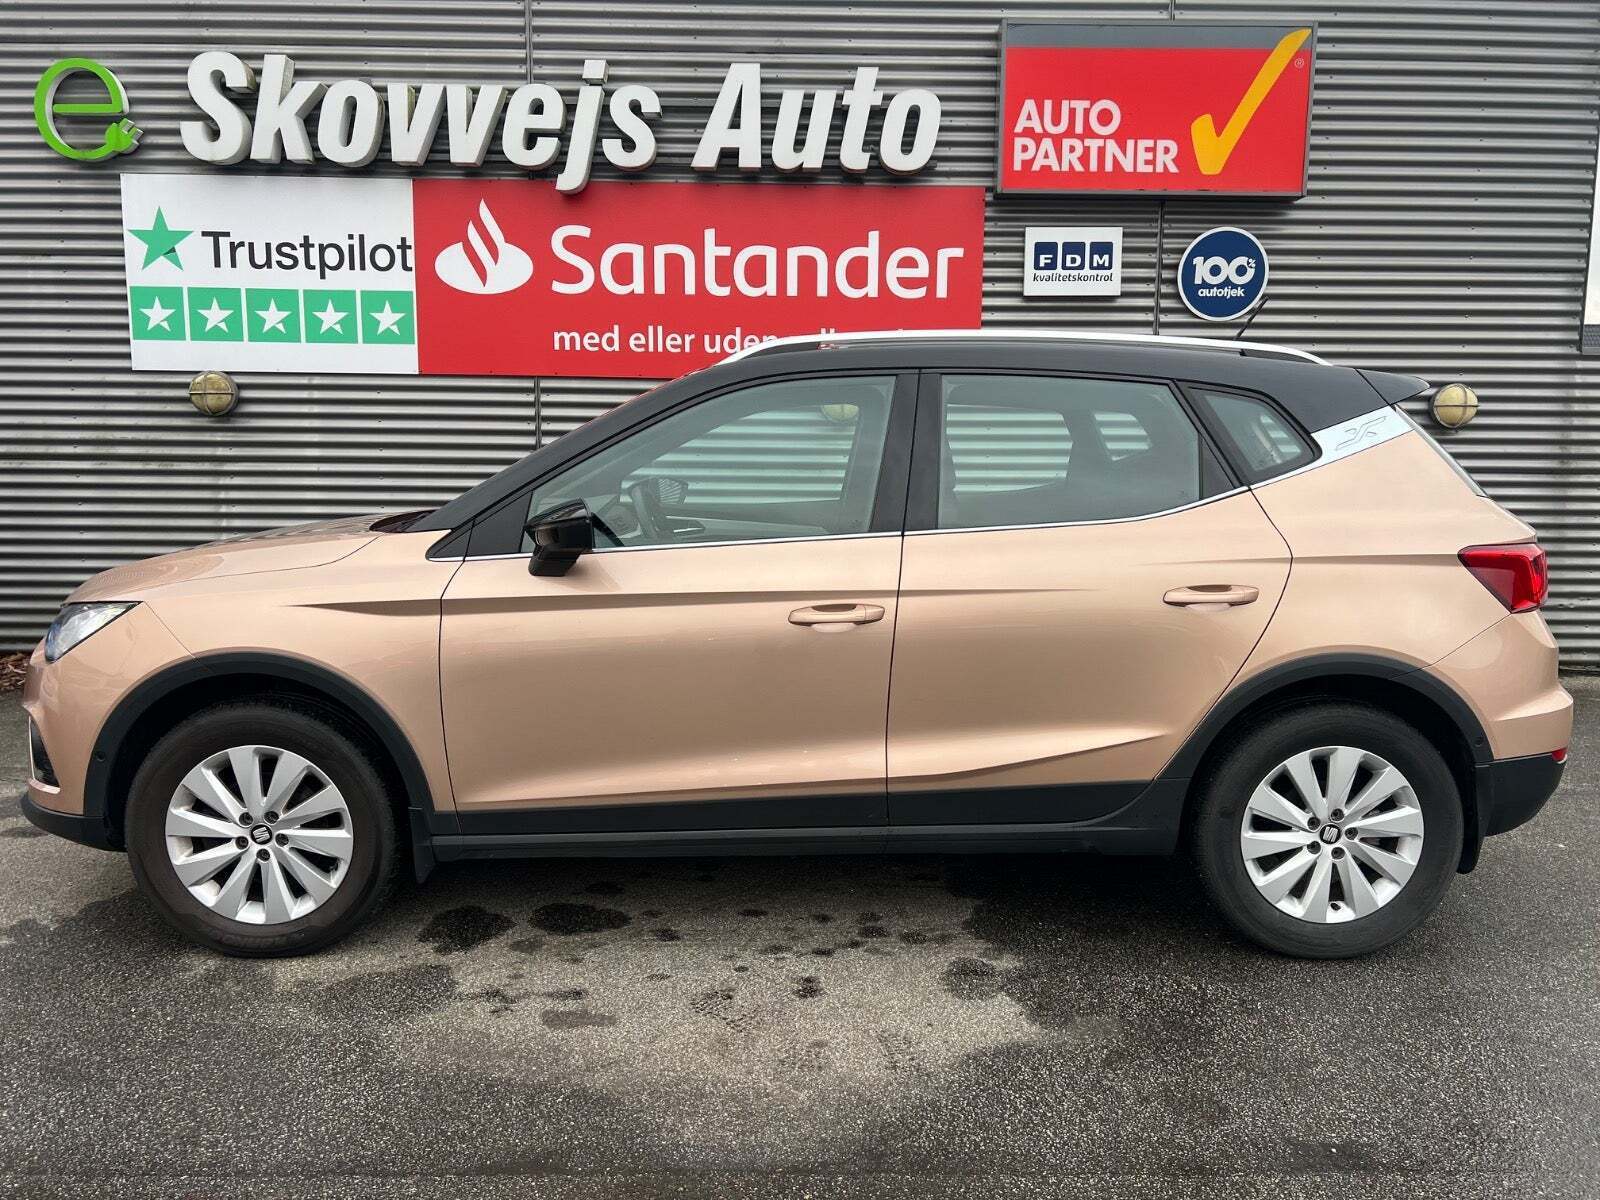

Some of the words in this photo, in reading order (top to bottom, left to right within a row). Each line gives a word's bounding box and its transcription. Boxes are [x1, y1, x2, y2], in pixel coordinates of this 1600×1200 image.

[180, 50, 662, 194] Skovvejs
[691, 62, 942, 173] Auto
[1013, 99, 1121, 136] AUTO
[1012, 137, 1179, 173] PARTNER
[201, 230, 413, 279] Trustpilot
[551, 225, 964, 299] Santander
[1038, 254, 1110, 267] FDM
[1033, 272, 1113, 283] kvalitetskontrol
[1198, 286, 1245, 299] autotjek
[553, 324, 620, 352] med
[628, 325, 695, 353] eller
